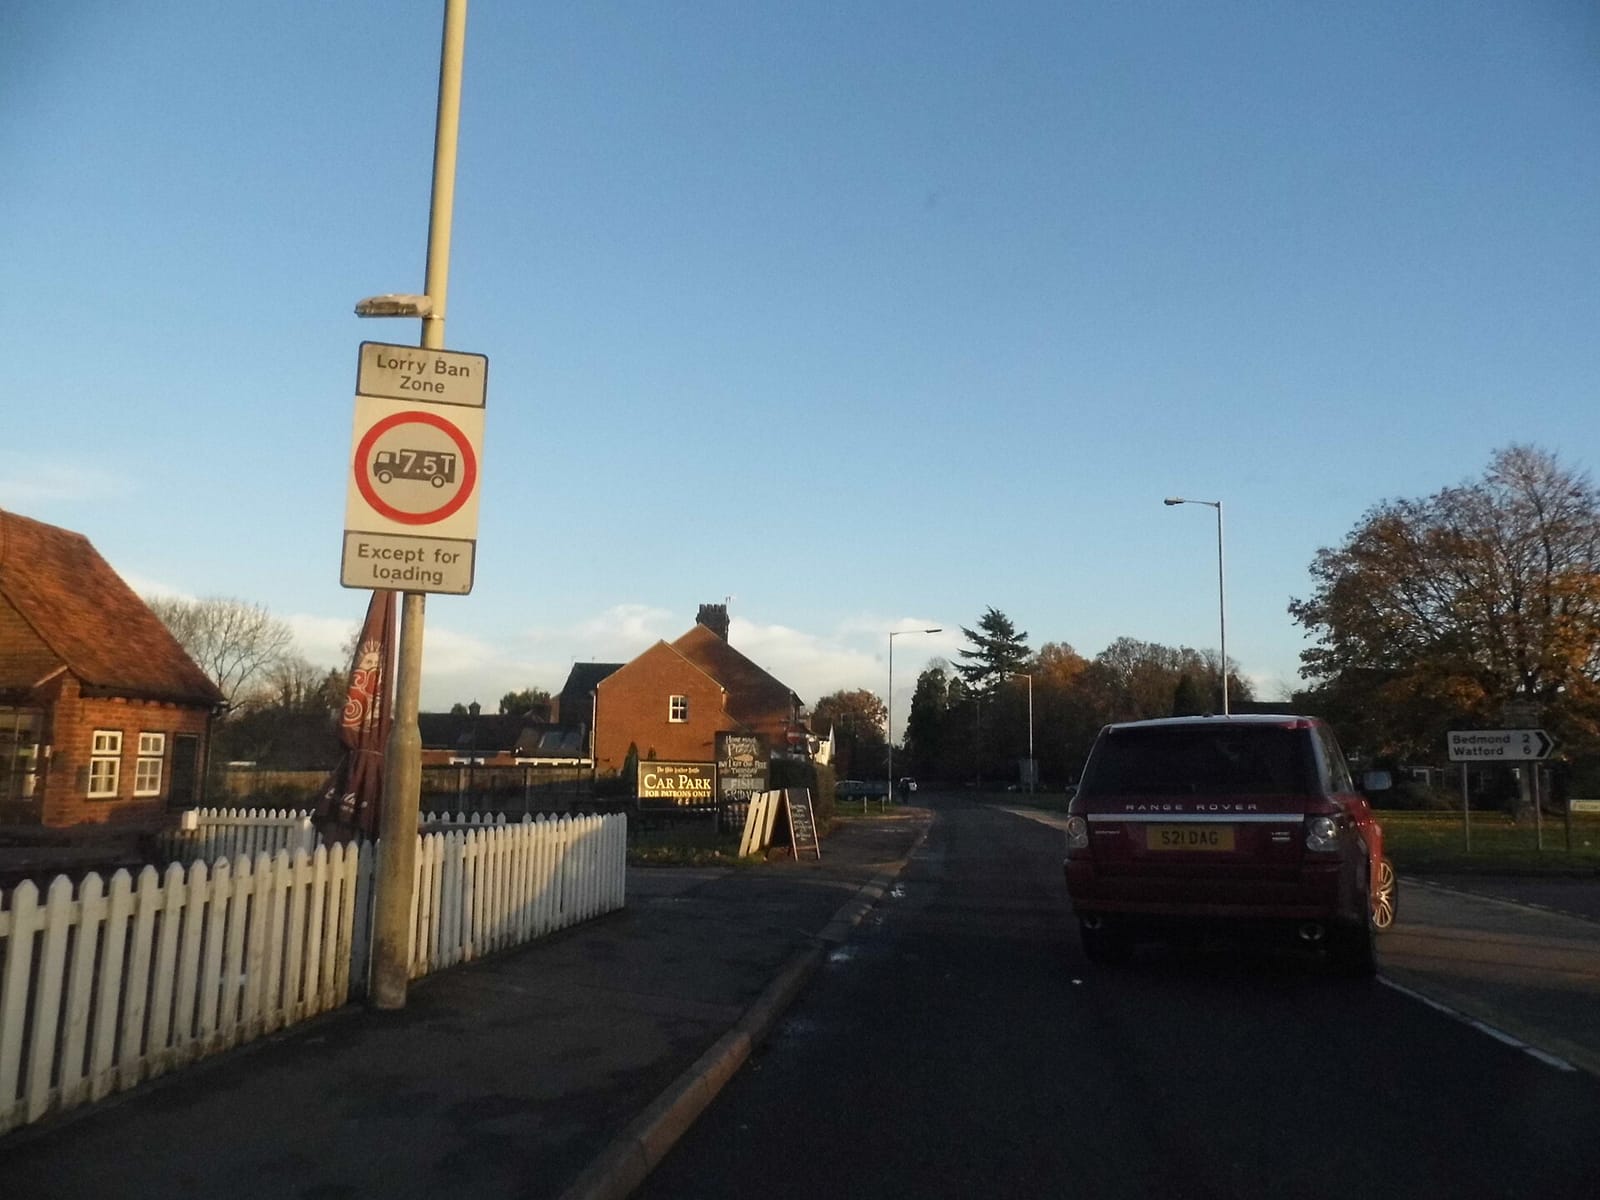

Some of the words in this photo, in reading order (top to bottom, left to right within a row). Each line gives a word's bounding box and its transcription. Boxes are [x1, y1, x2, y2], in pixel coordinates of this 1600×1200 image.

[377, 354, 426, 374] Lorry
[434, 360, 470, 377] Ban
[400, 376, 445, 393] Zone
[401, 451, 455, 475] 7.5T
[357, 543, 425, 564] Except
[434, 548, 460, 564] for
[373, 563, 443, 585] loading
[1452, 734, 1511, 744] Bedmond
[1523, 734, 1530, 743] 2
[1453, 746, 1504, 756] Watford
[644, 773, 675, 789] CAR
[678, 774, 711, 790] PARK
[1125, 803, 1183, 811] RANGE
[1196, 803, 1258, 811] ROVER
[1162, 830, 1184, 846] S21
[1189, 830, 1218, 845] DAG
